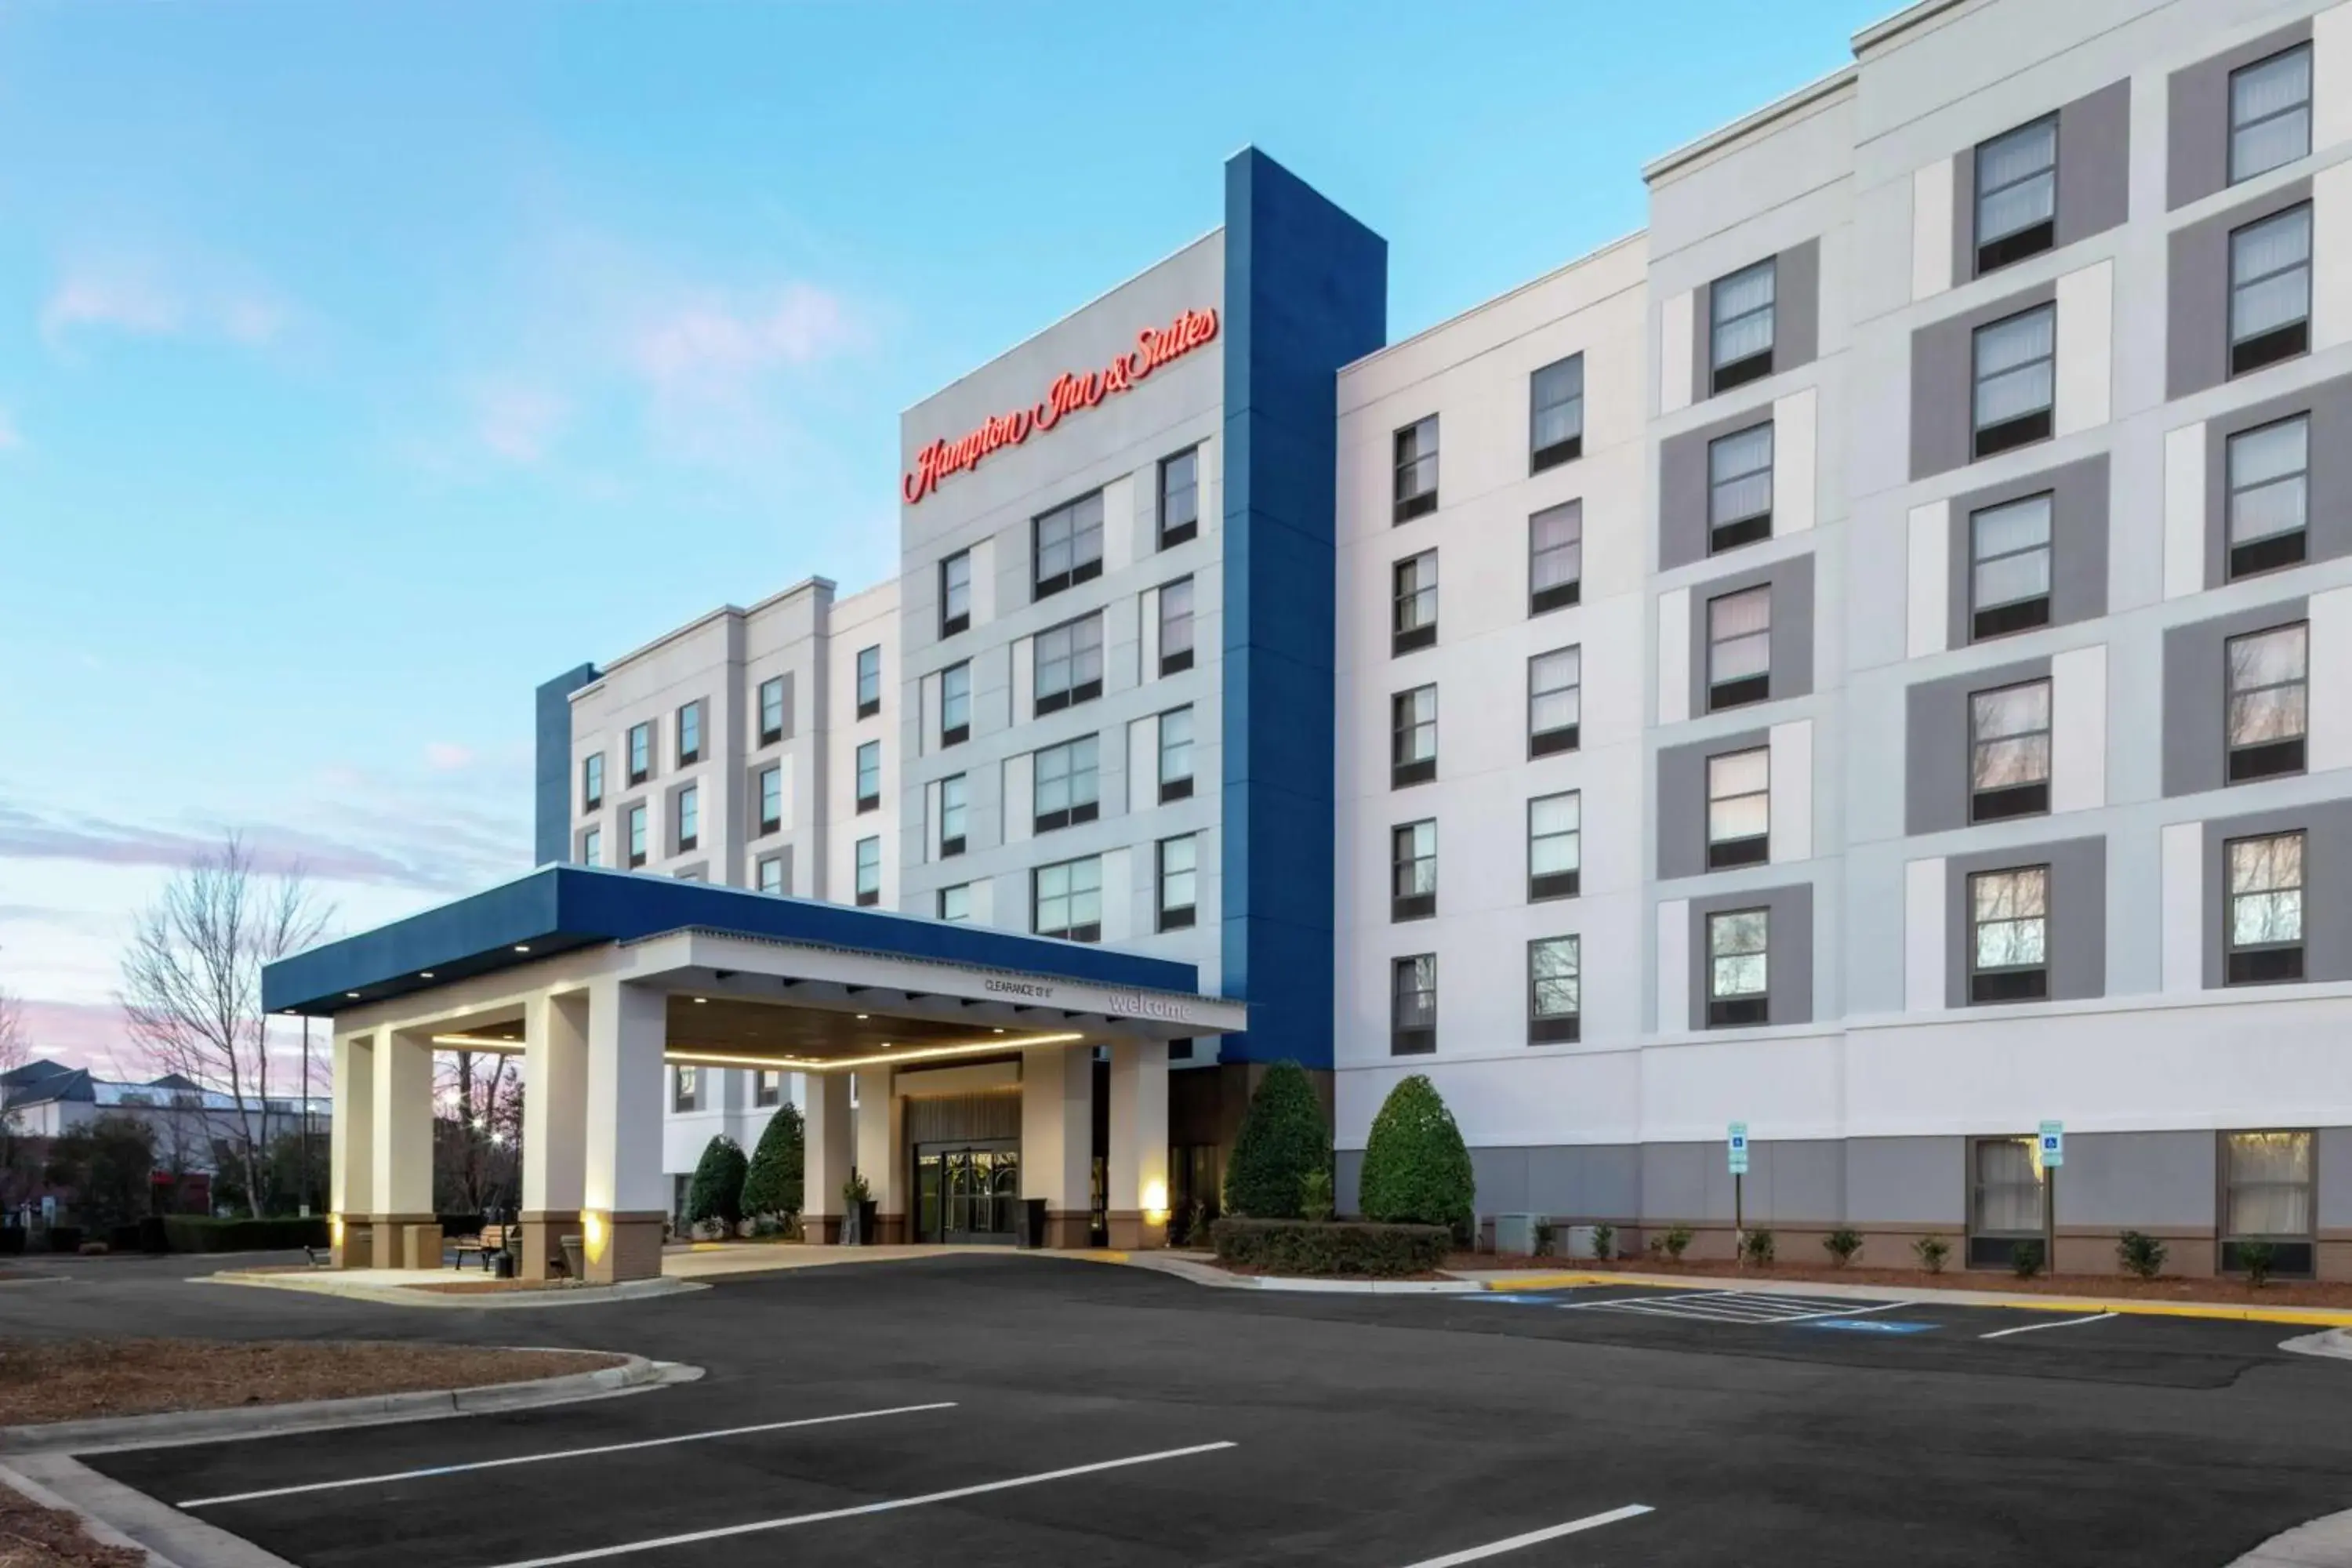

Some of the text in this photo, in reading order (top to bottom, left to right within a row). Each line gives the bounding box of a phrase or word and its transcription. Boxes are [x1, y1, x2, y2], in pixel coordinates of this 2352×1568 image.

[903, 307, 1220, 504] Hampton Inn & Suites
[985, 979, 1034, 996] CLEARANCE
[1109, 991, 1192, 1019] welcome
